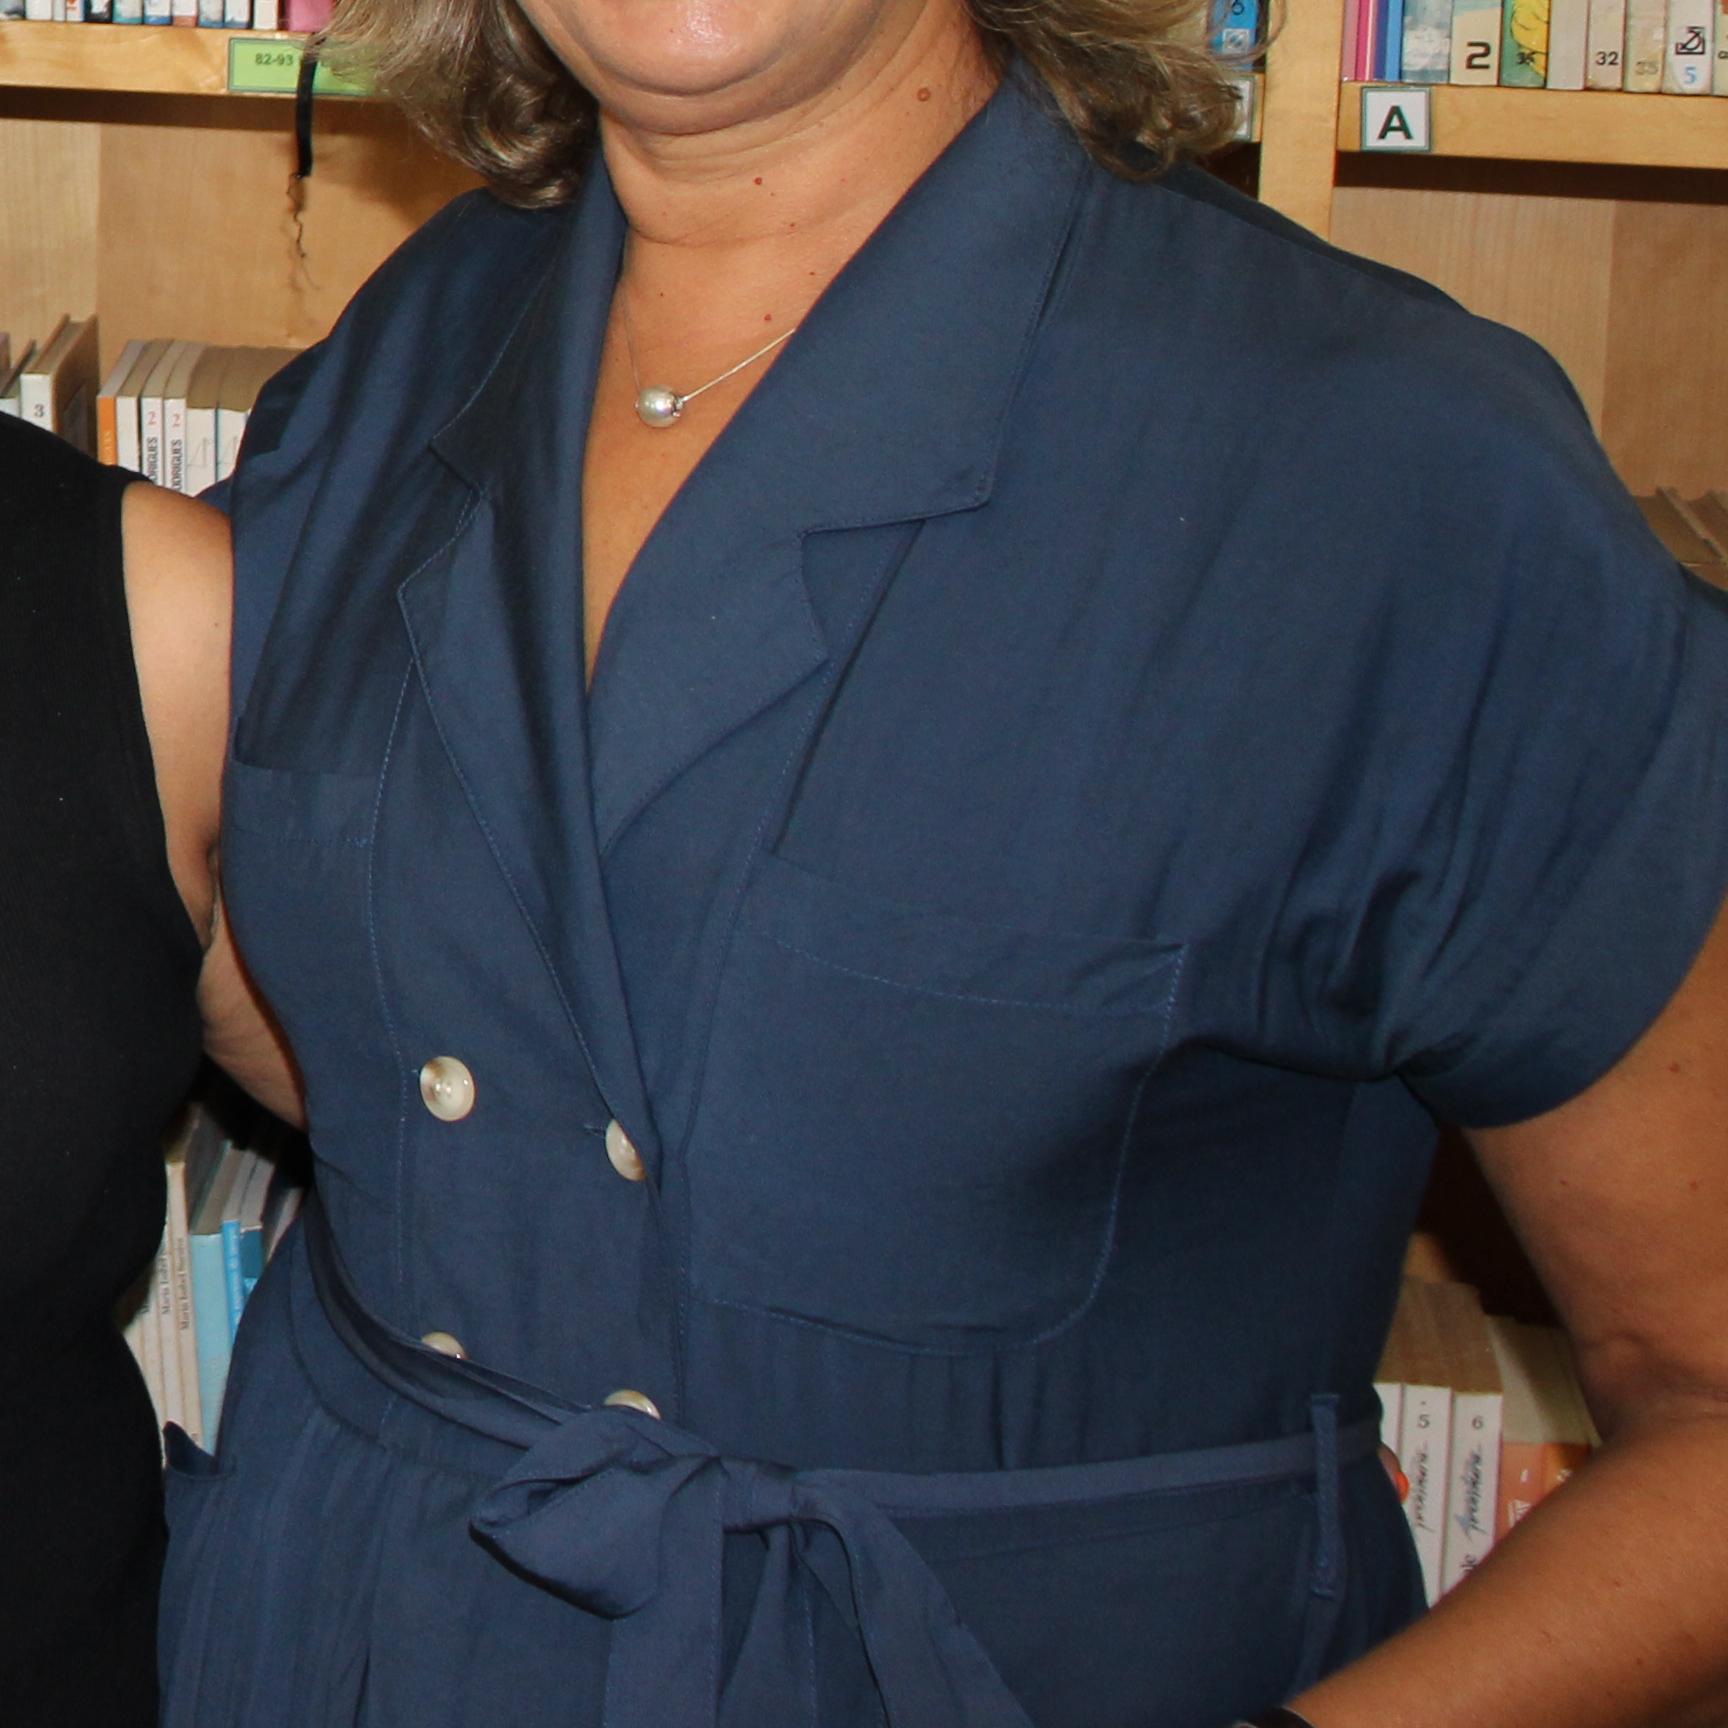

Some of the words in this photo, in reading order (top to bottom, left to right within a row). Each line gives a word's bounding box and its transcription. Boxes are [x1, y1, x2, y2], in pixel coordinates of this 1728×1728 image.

[1465, 41, 1491, 70] 2
[1595, 51, 1621, 67] 32
[1683, 66, 1698, 85] 5
[1376, 105, 1414, 140] A
[33, 403, 45, 418] 3
[147, 410, 157, 426] 2
[172, 412, 182, 428] 2
[1417, 1413, 1431, 1430] 5
[1471, 1415, 1483, 1430] 6
